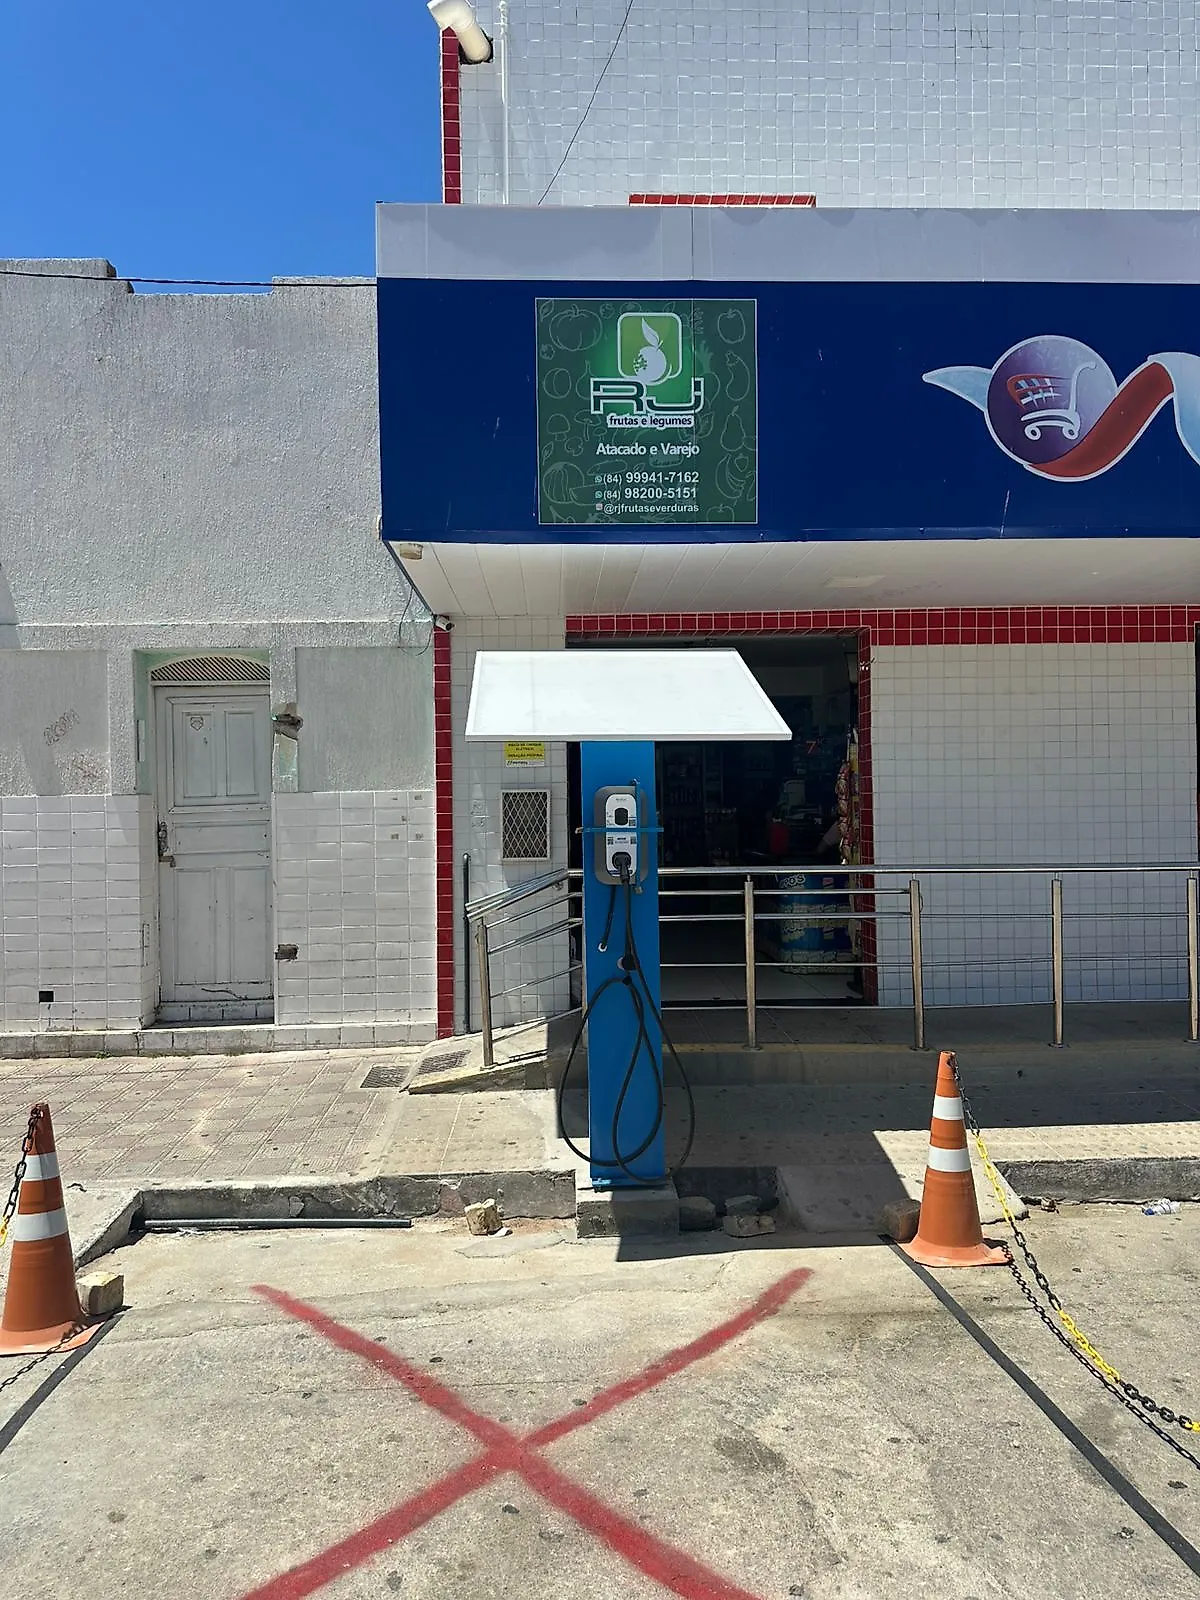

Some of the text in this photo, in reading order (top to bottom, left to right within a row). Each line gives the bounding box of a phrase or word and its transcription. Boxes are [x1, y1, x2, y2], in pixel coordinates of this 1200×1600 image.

[590, 377, 704, 415] RJ
[609, 415, 692, 428] frutas e legumes
[596, 442, 700, 458] Atacado e Varejo
[603, 471, 699, 486] (84) 99941-7162
[603, 487, 696, 500] (84) 98200-5151
[603, 503, 699, 514] @rjfrutaseverduras
